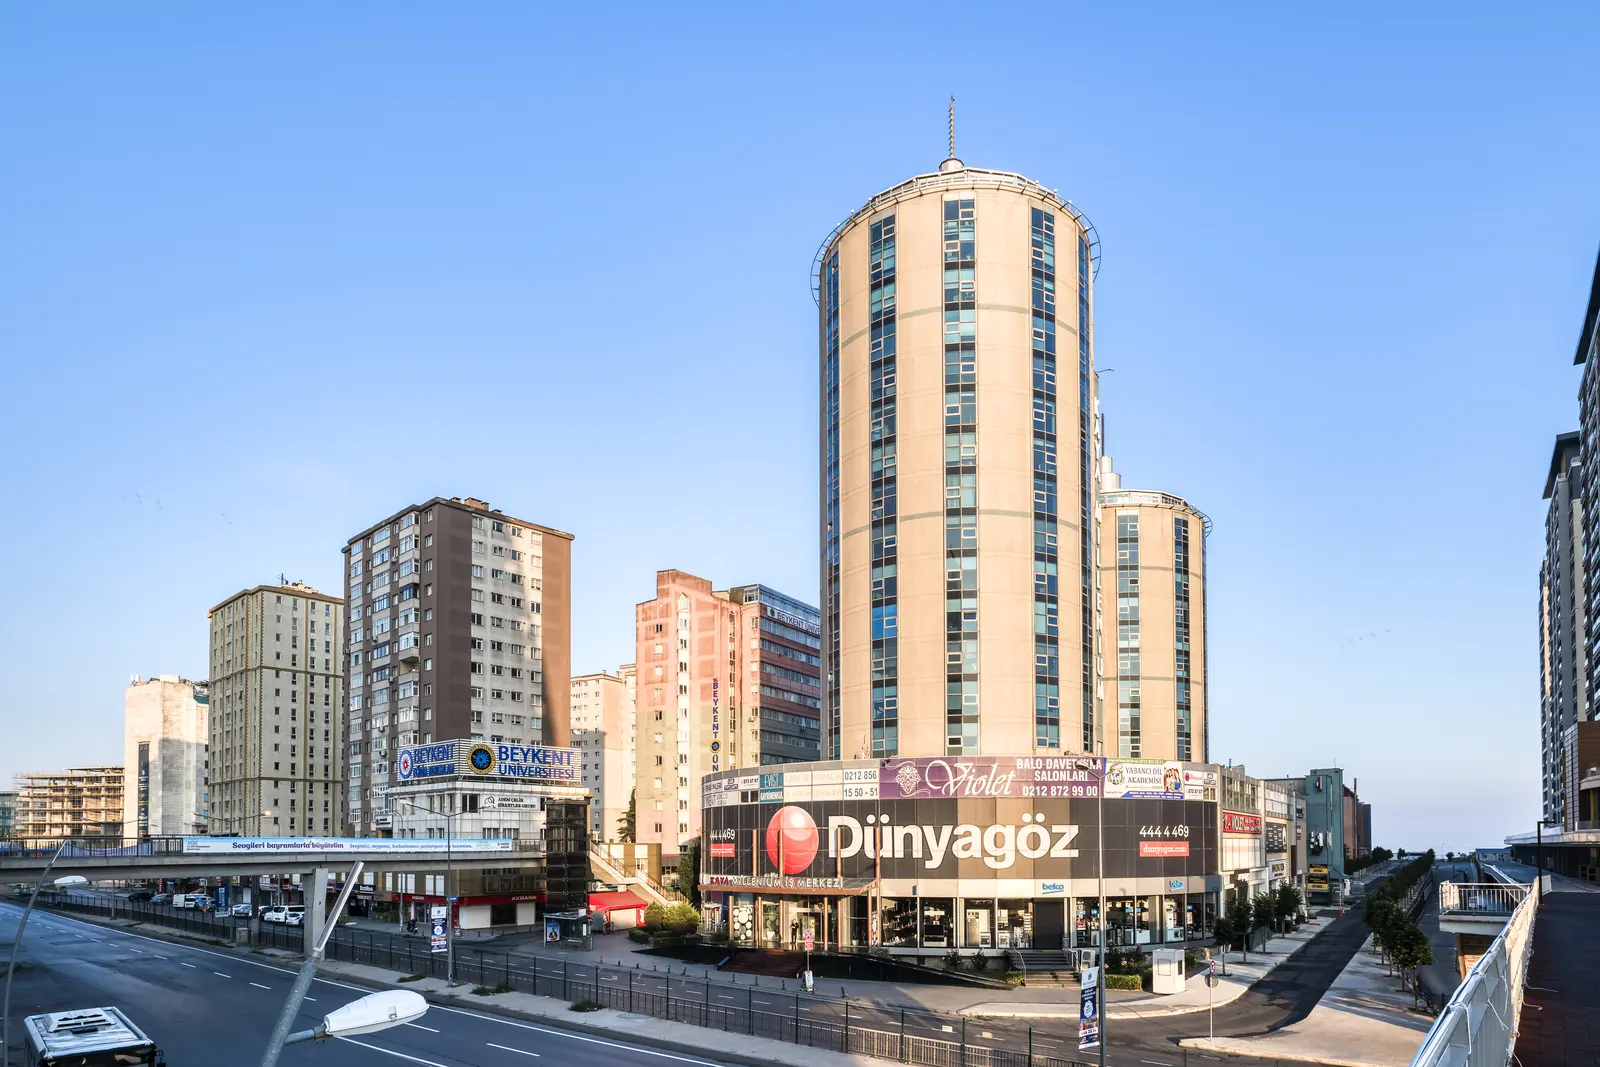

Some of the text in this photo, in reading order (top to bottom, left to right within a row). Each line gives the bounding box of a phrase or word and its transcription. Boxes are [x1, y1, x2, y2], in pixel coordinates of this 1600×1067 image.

[777, 611, 806, 630] BEYKENT
[414, 743, 455, 763] BEYKENT
[498, 745, 574, 766] BEYKENT
[498, 761, 575, 779] ÜNİVERSİTESİ
[1016, 758, 1042, 770] BALO
[1045, 758, 1078, 770] DAVET
[844, 770, 877, 780] 0212 856
[1034, 770, 1088, 782] SALONLARI
[1125, 766, 1152, 775] YABANCI
[925, 759, 1016, 797] Violet
[1127, 775, 1162, 784] AKADEMİSİ
[844, 788, 852, 797] 15
[854, 787, 863, 797] 50
[869, 787, 878, 797] 51
[1022, 786, 1098, 797] 0212 872 99 00
[722, 827, 736, 840] 469
[1139, 824, 1189, 838] 444 4 469
[232, 841, 344, 850] Sevgileri bayramlarla büyütelim
[828, 813, 1079, 869] Dünyagöz
[1143, 843, 1187, 855] dunyagoz.com
[710, 877, 729, 885] KAYA
[785, 876, 795, 888] İŞ
[797, 876, 844, 888] MERKEZİ
[1042, 882, 1064, 892] beko
